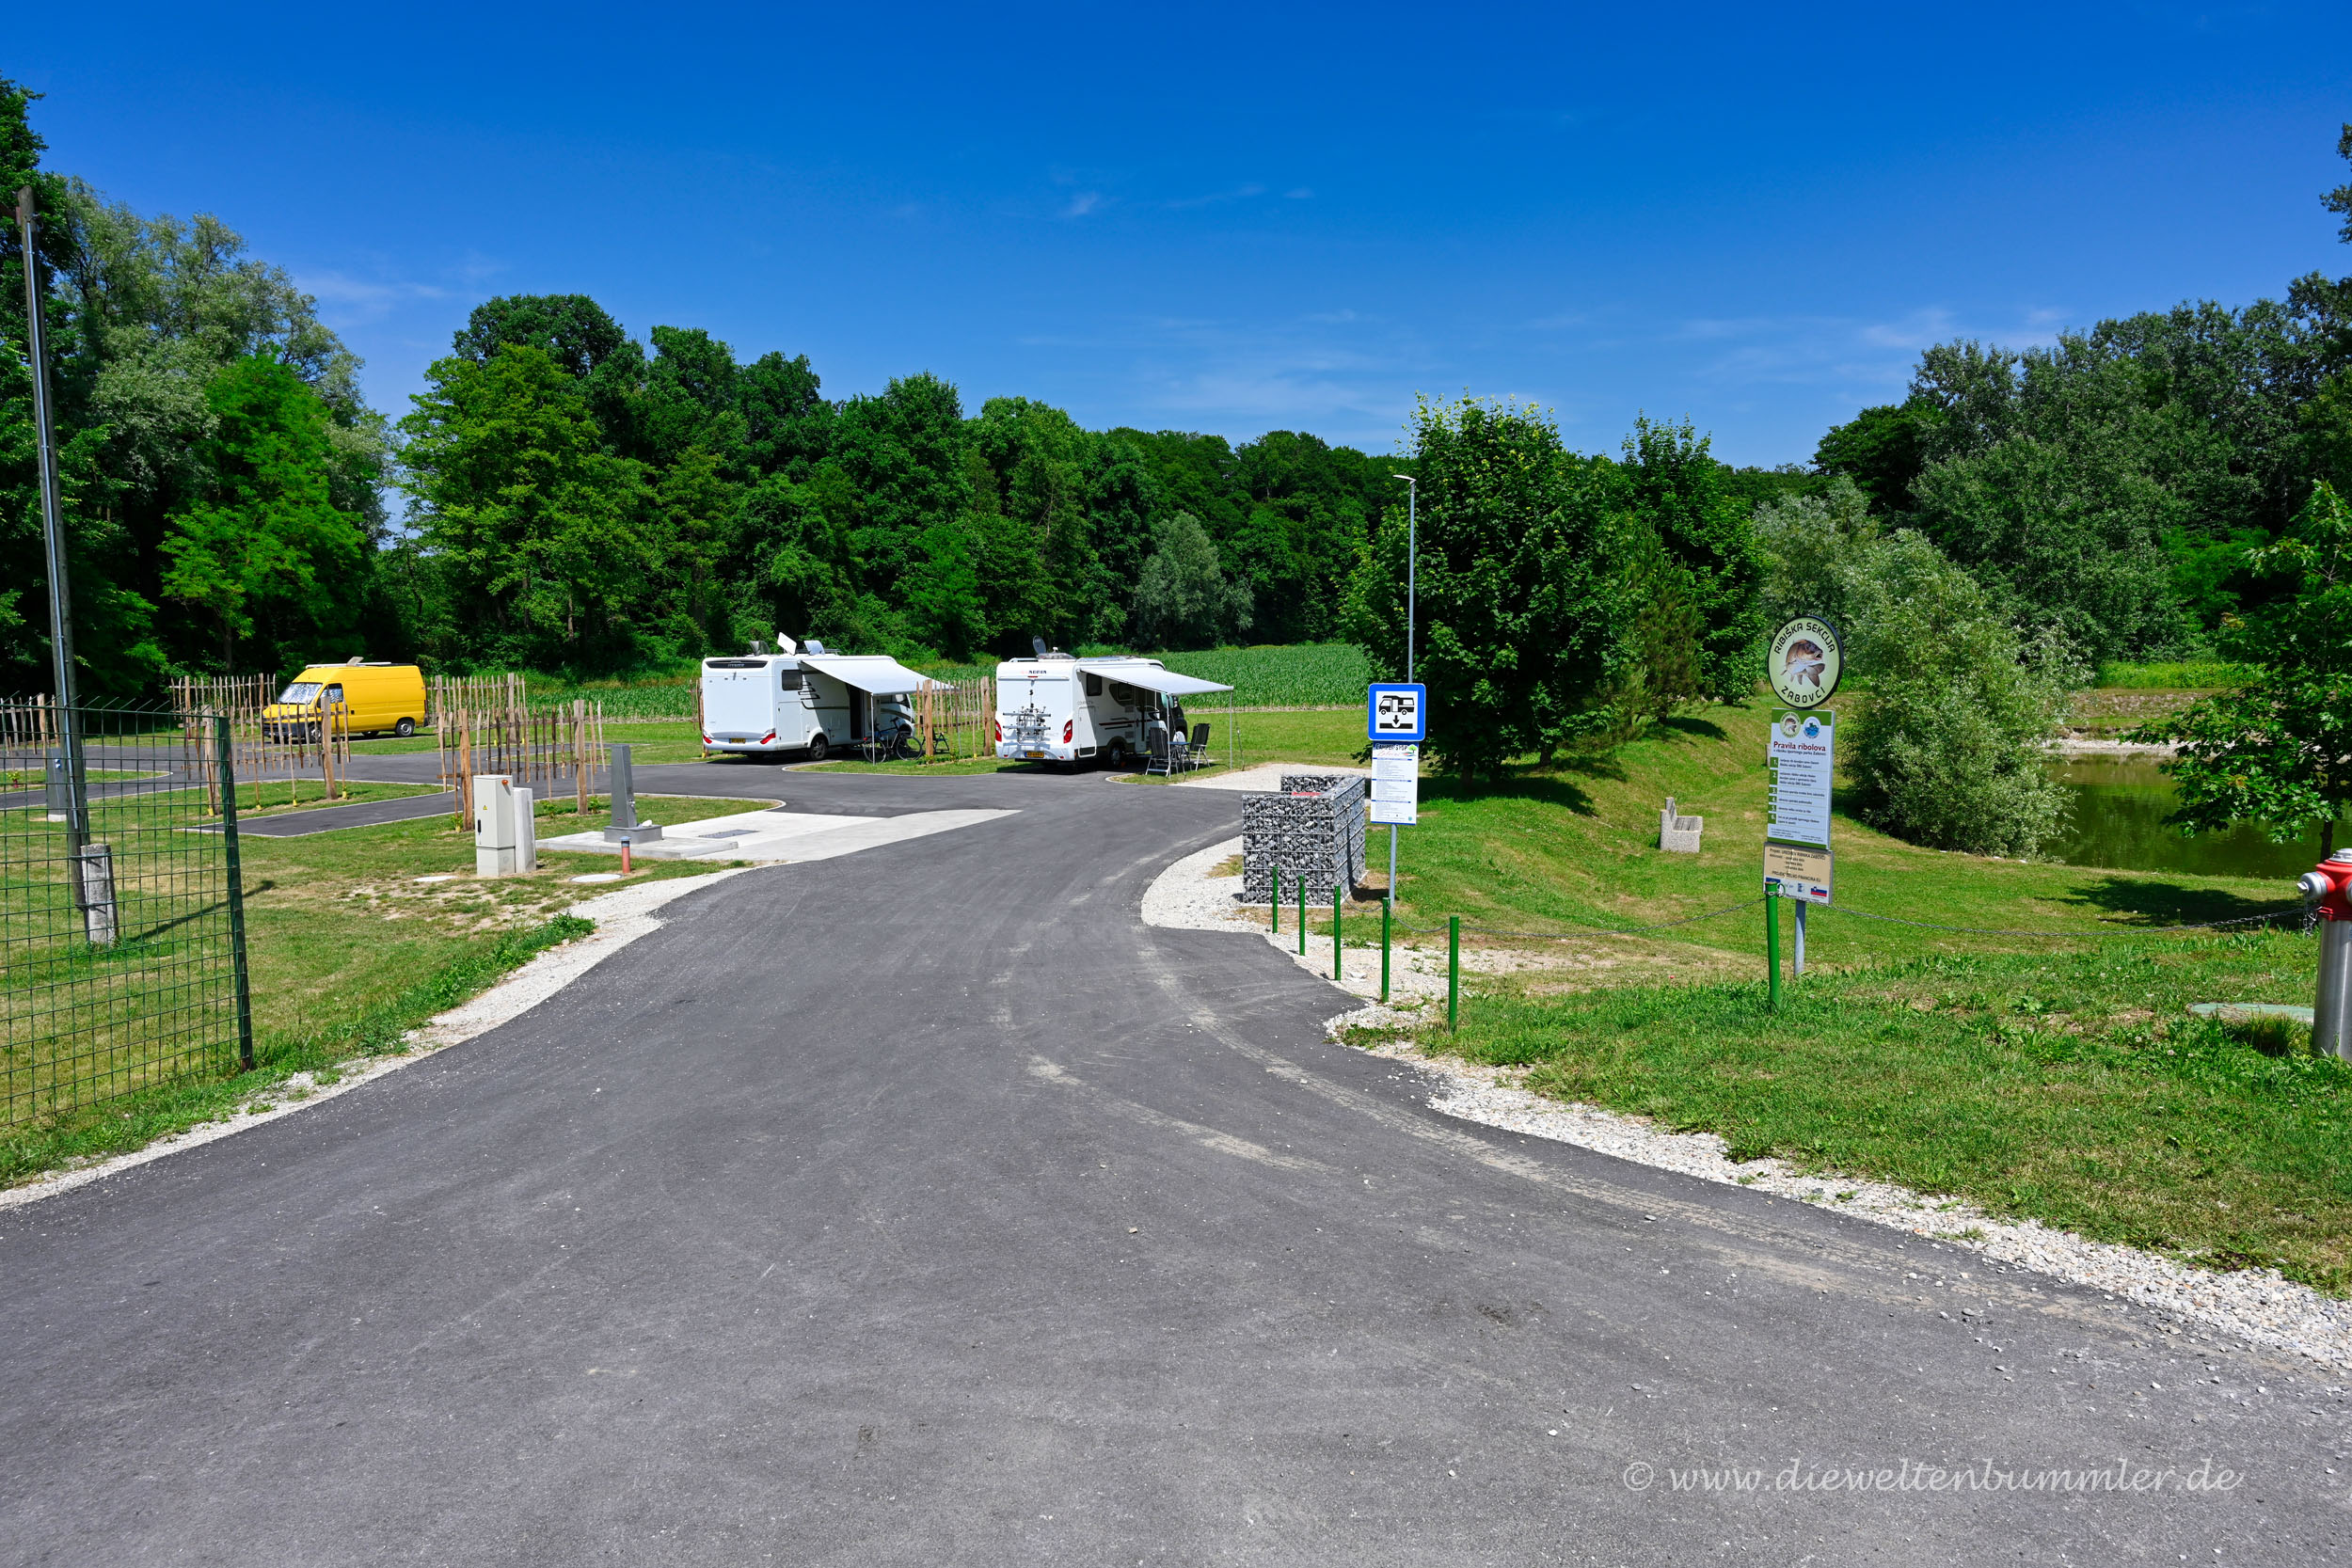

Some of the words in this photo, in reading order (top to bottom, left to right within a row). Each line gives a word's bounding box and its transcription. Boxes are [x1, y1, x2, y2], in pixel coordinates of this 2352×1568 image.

[1774, 623, 1804, 654] RIBIŠKA
[1806, 622, 1836, 653] SEKCIJA
[1781, 685, 1825, 704] ZABOVCI
[1773, 741, 1796, 750] Pravila
[1798, 743, 1826, 752] ribolova
